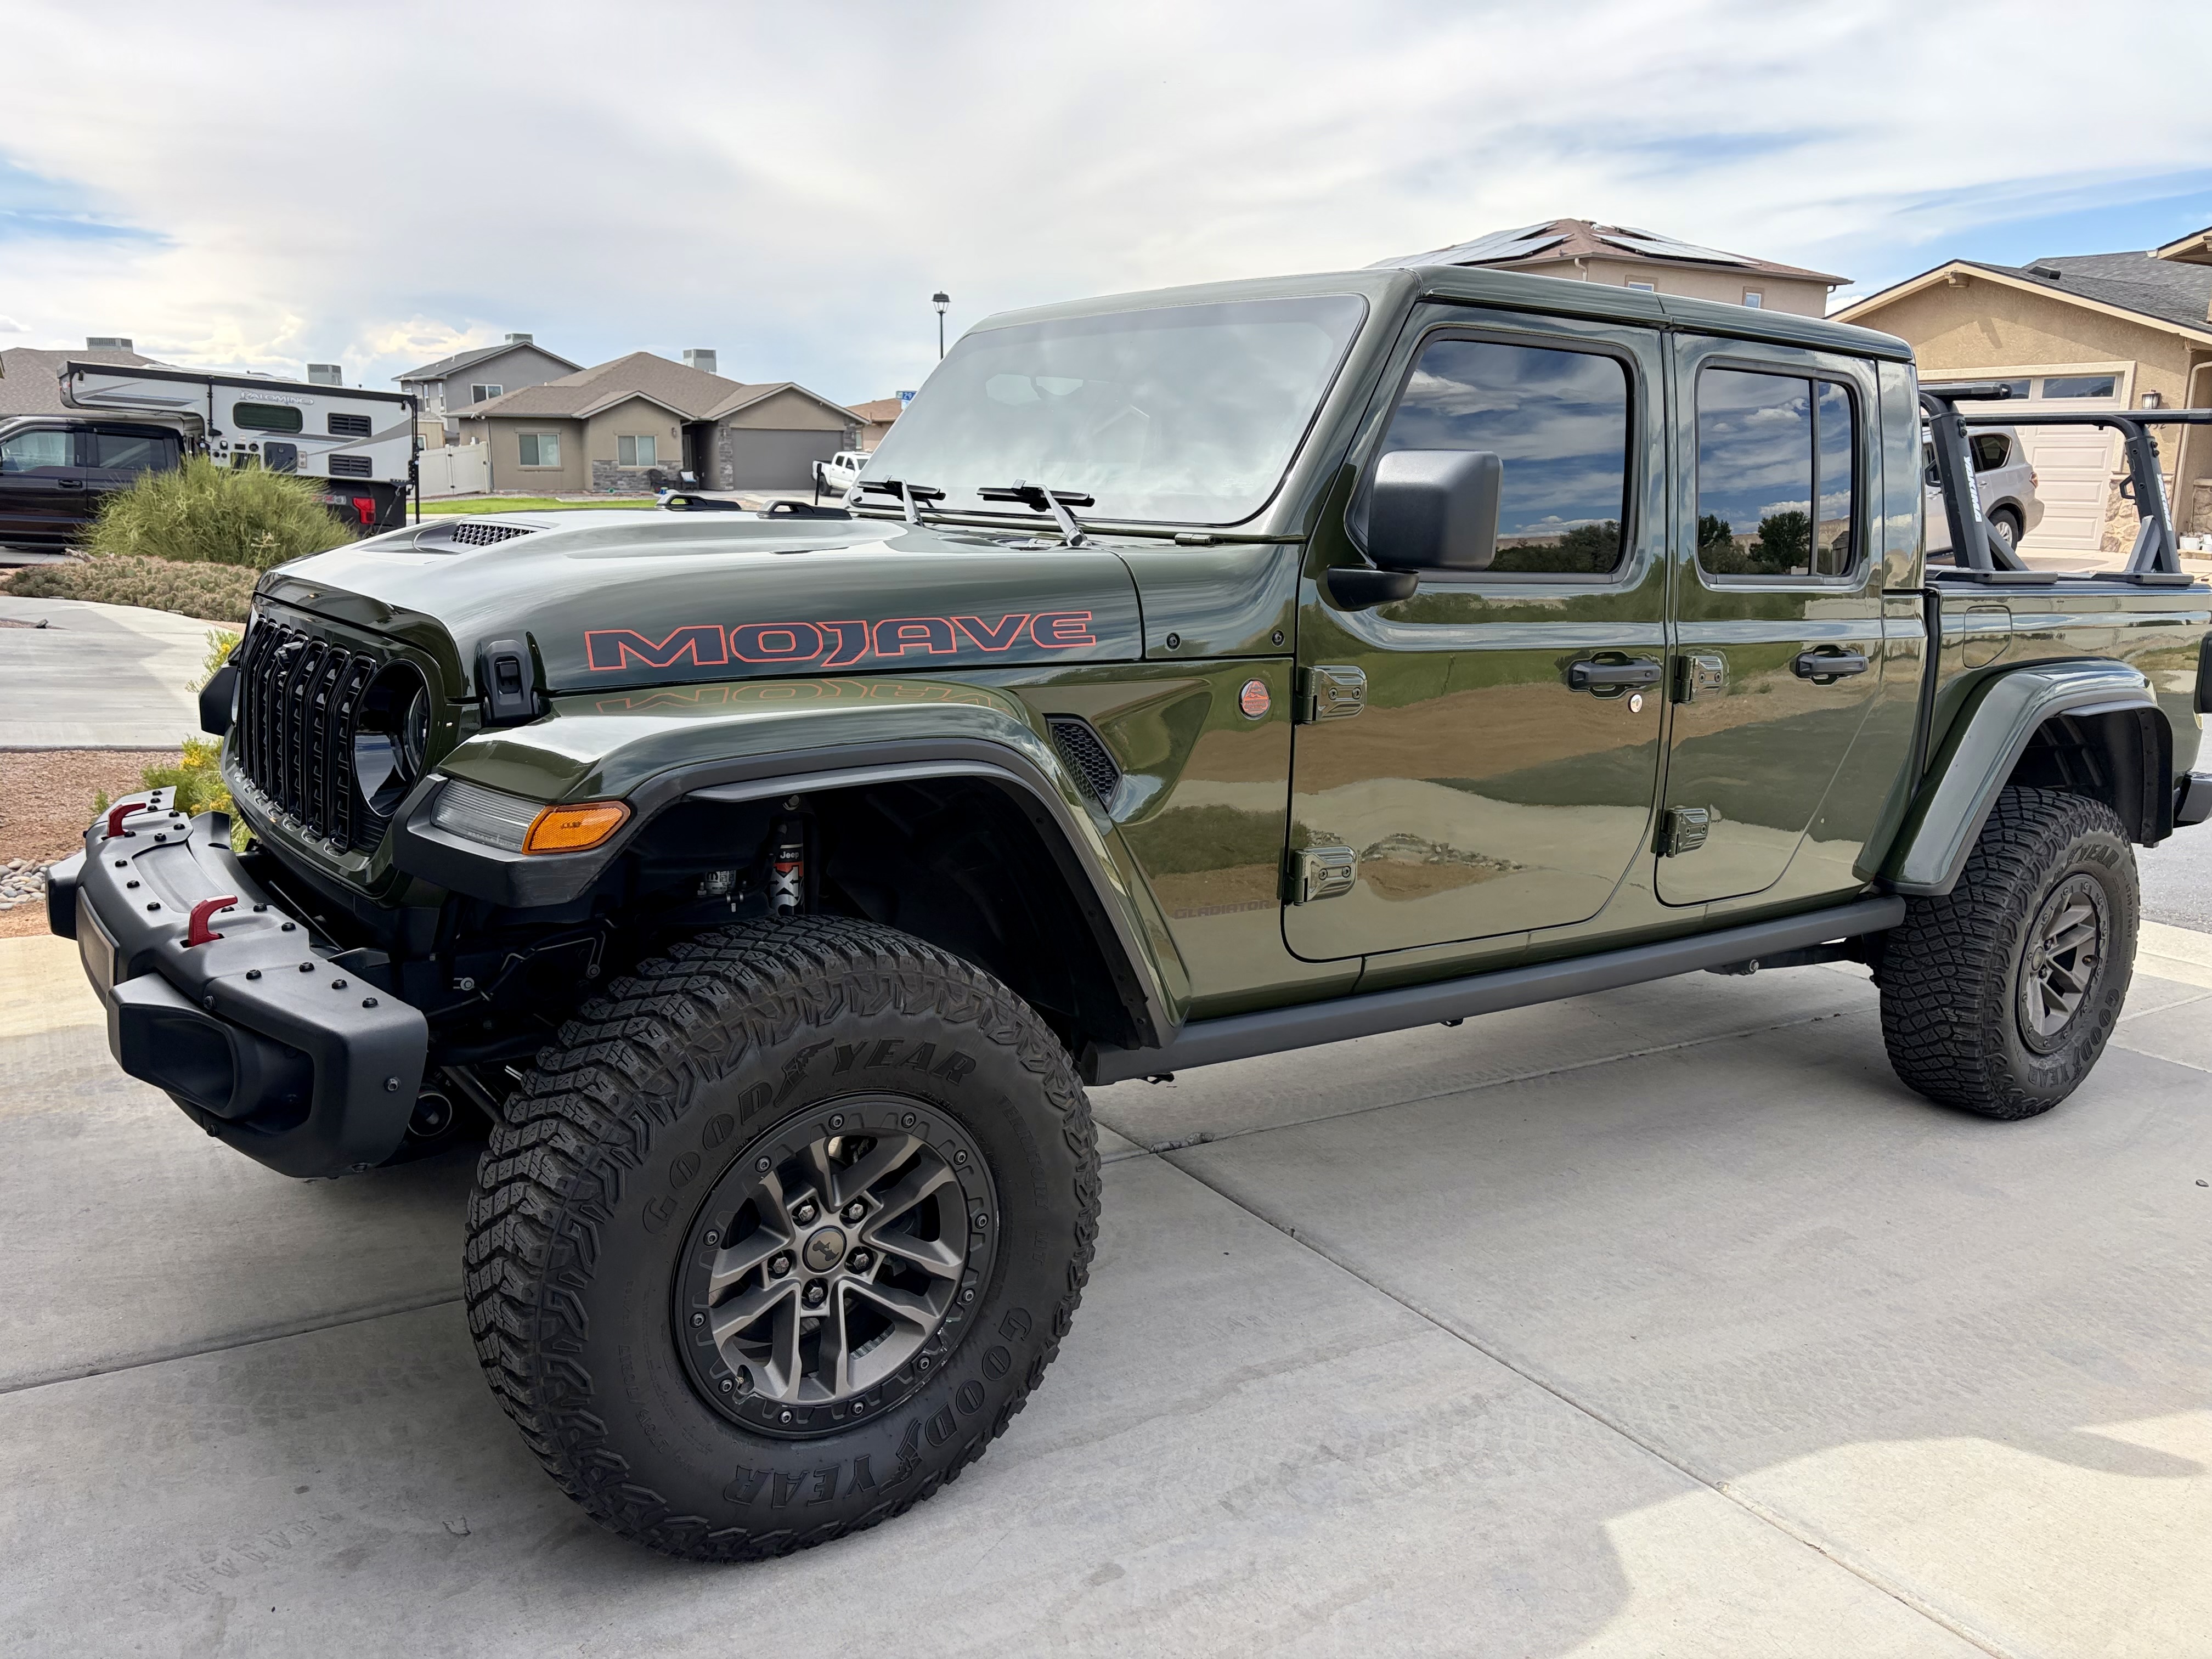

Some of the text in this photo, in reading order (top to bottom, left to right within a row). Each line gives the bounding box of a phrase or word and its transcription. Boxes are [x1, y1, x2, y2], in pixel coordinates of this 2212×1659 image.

[239, 390, 314, 405] PALOMINO
[1963, 456, 1983, 522] YAKIMA
[2157, 473, 2173, 531] YAKIMA
[585, 611, 1097, 672] MOJAVE
[780, 851, 799, 859] Jeep
[1174, 899, 1271, 919] GLADIATOR
[995, 1094, 1049, 1267] TERRITORY MT
